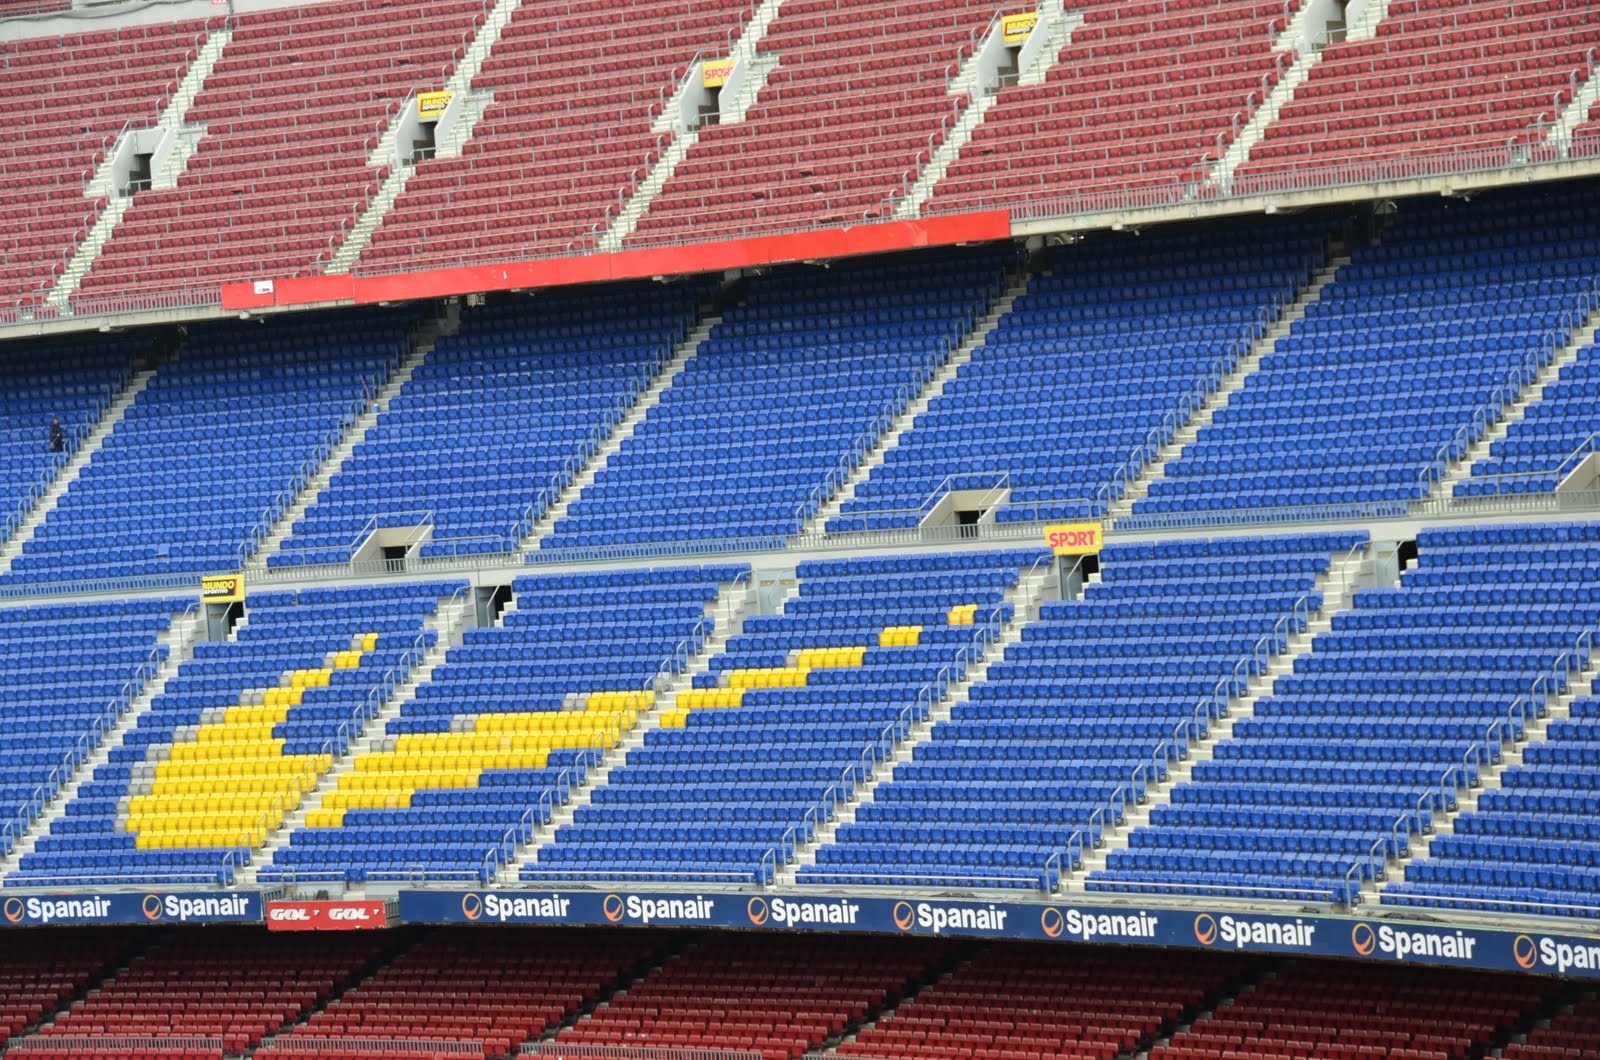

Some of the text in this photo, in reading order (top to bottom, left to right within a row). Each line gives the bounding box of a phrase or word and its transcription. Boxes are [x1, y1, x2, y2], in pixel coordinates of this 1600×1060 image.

[1006, 19, 1036, 31] MUNDO
[422, 95, 450, 107] MUNDO
[203, 580, 235, 590] MUNDO
[27, 895, 111, 922] Spanair
[164, 893, 249, 921] Spanair
[484, 893, 571, 922] Spanair
[626, 895, 714, 923] Spanair
[771, 898, 859, 927] Spanair
[916, 902, 1008, 933] Spanair
[1066, 909, 1158, 940] Spanair
[1219, 916, 1316, 948] Spanair
[1378, 925, 1476, 960] Spanair
